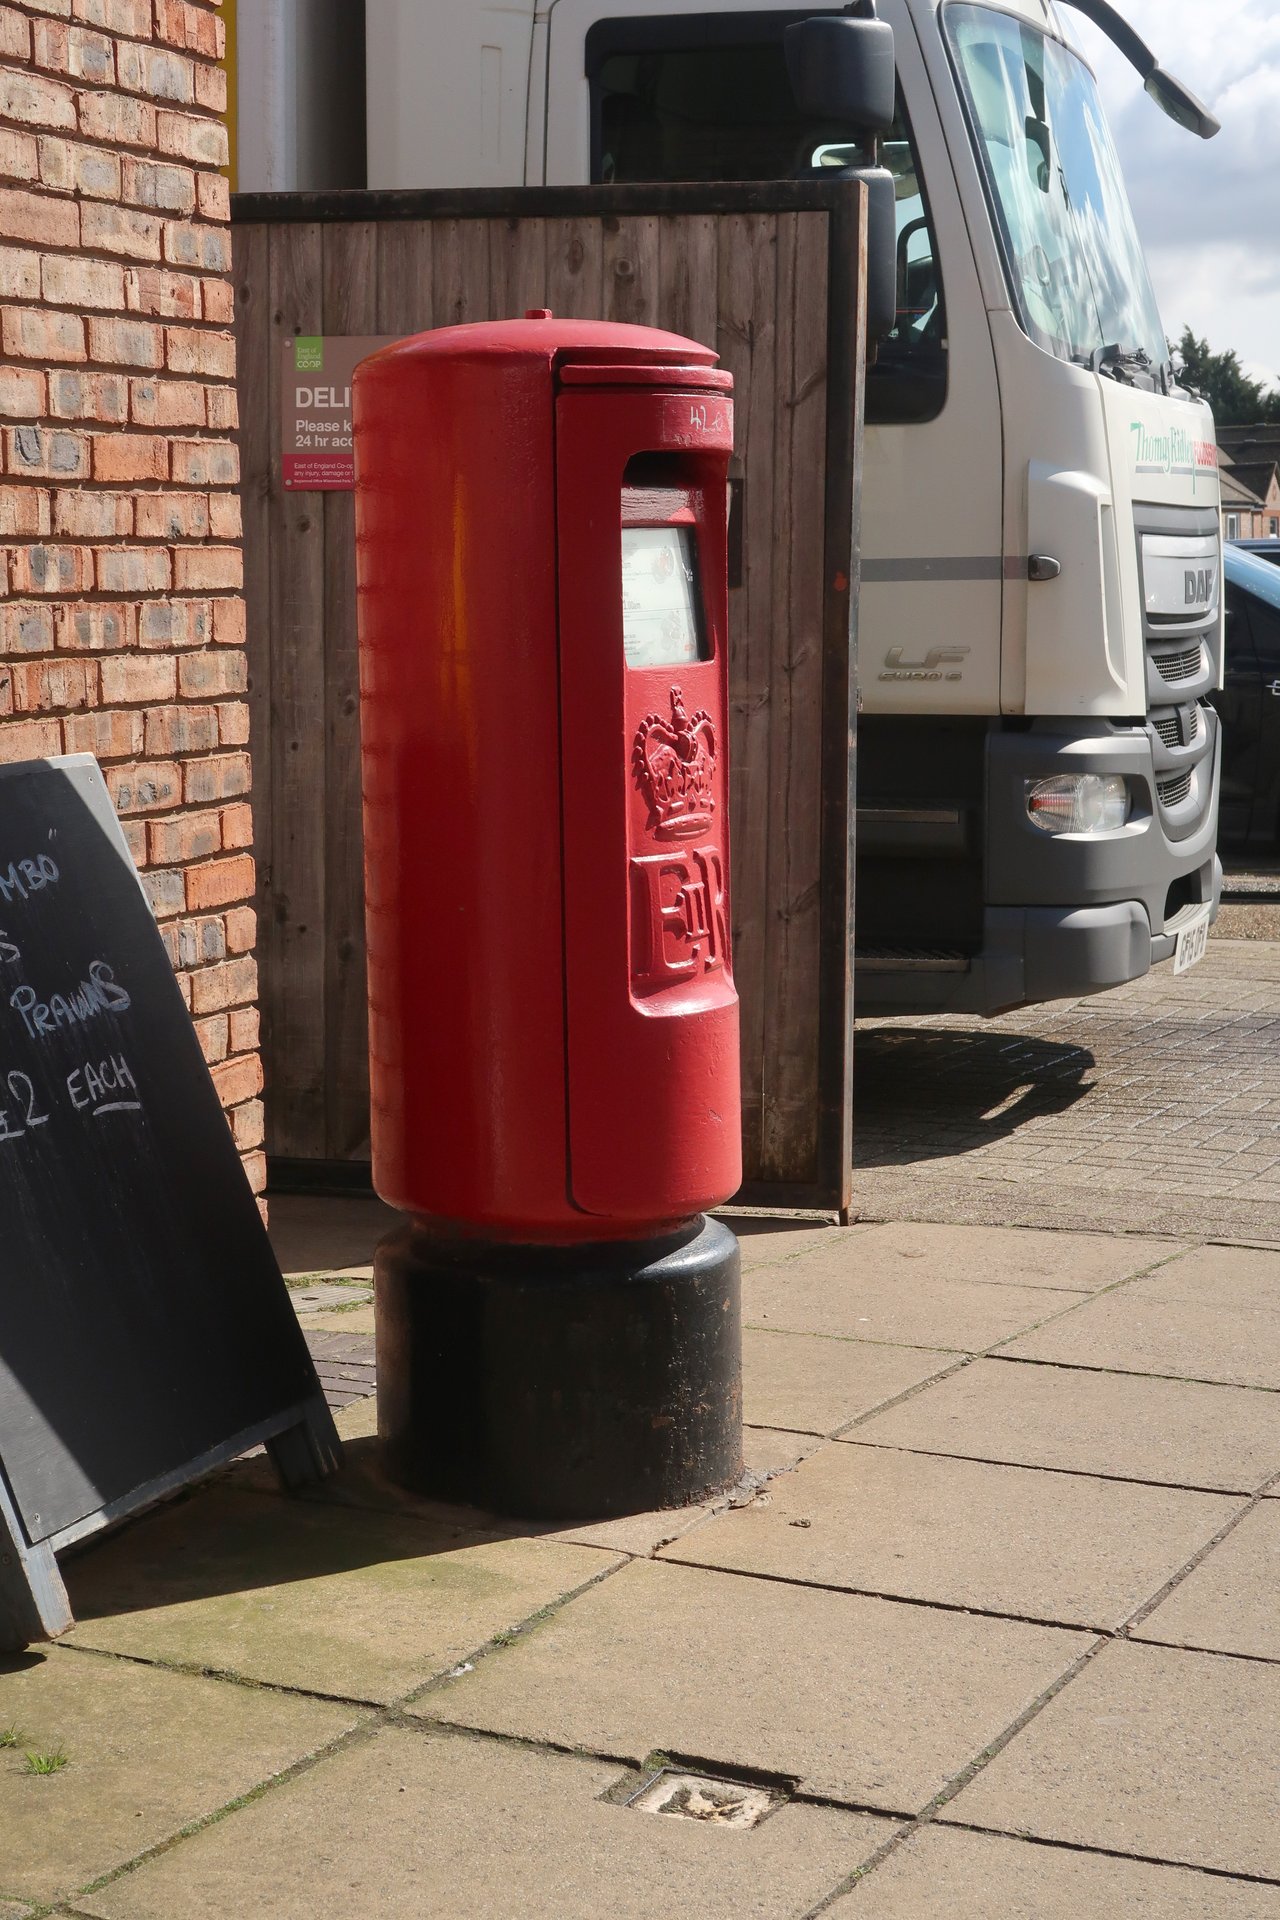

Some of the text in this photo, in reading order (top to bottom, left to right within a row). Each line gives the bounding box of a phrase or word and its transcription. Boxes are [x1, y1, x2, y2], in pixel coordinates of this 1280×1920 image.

[296, 387, 352, 408] DELI
[296, 420, 340, 432] Please
[296, 435, 311, 447] 24
[315, 435, 328, 447] hr
[313, 462, 336, 470] England
[1184, 569, 1213, 604] DAF
[884, 646, 970, 669] LF
[879, 671, 942, 681] EURO
[10, 960, 131, 1038] PRAWNS
[67, 1053, 137, 1110] EACH
